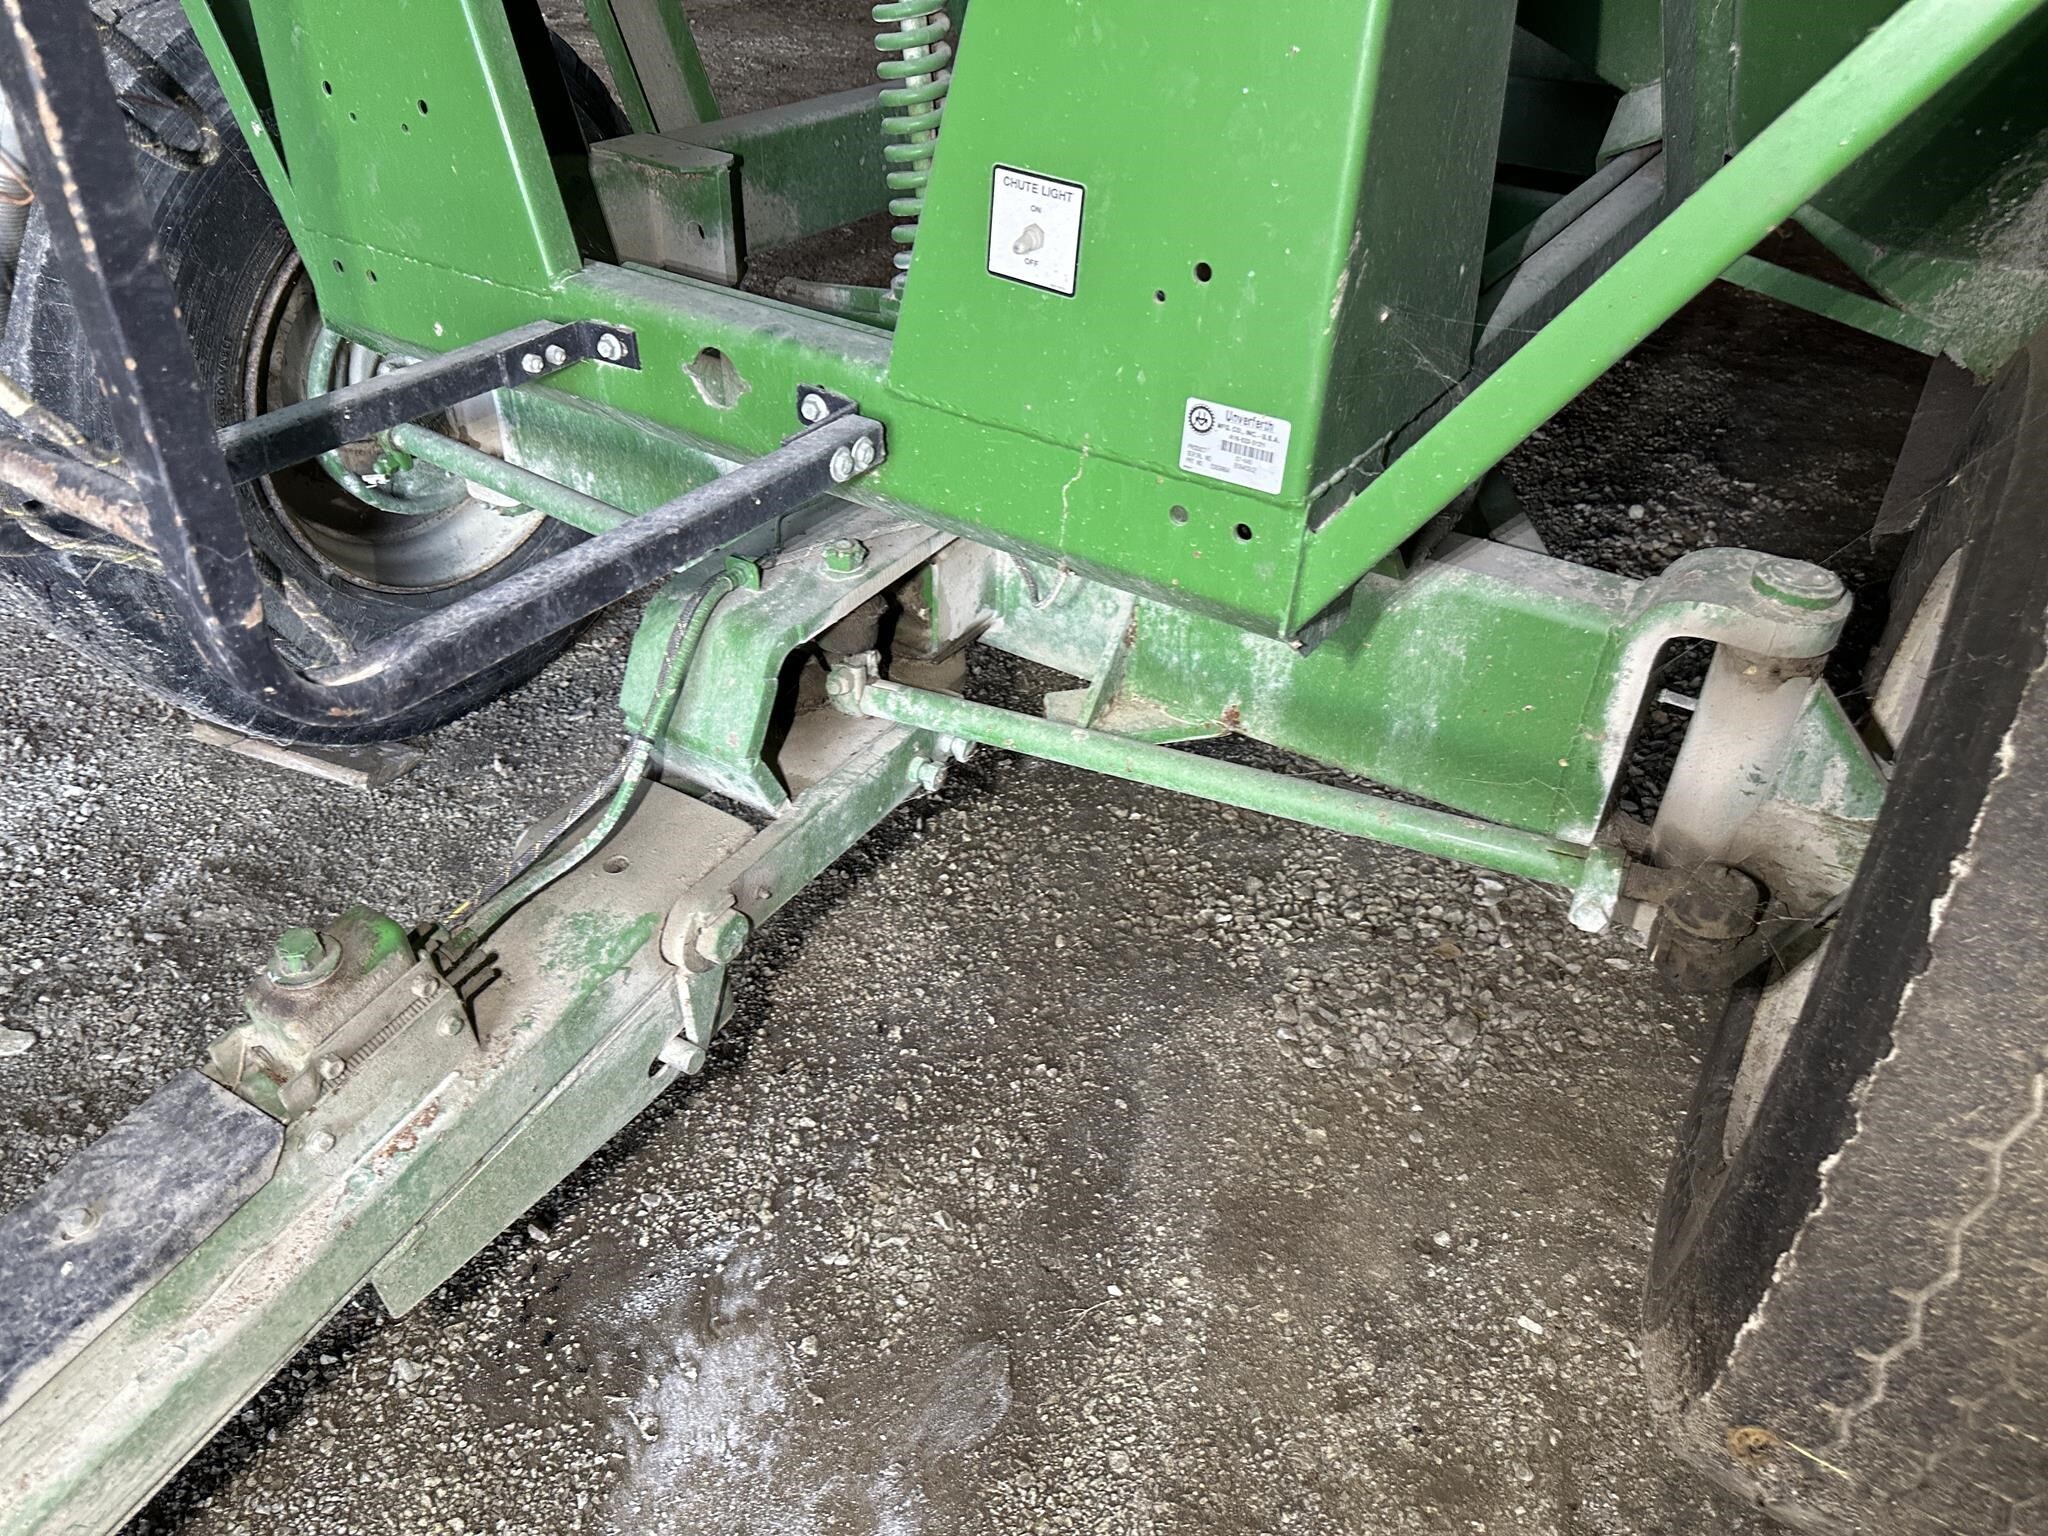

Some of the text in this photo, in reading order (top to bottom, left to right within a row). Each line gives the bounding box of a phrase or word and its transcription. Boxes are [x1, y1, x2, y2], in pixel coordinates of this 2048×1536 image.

[1003, 176, 1074, 202] CHUTE LIGHT
[1030, 205, 1042, 213] ON
[1024, 258, 1039, 266] OFF
[1226, 410, 1274, 433] Unverferth
